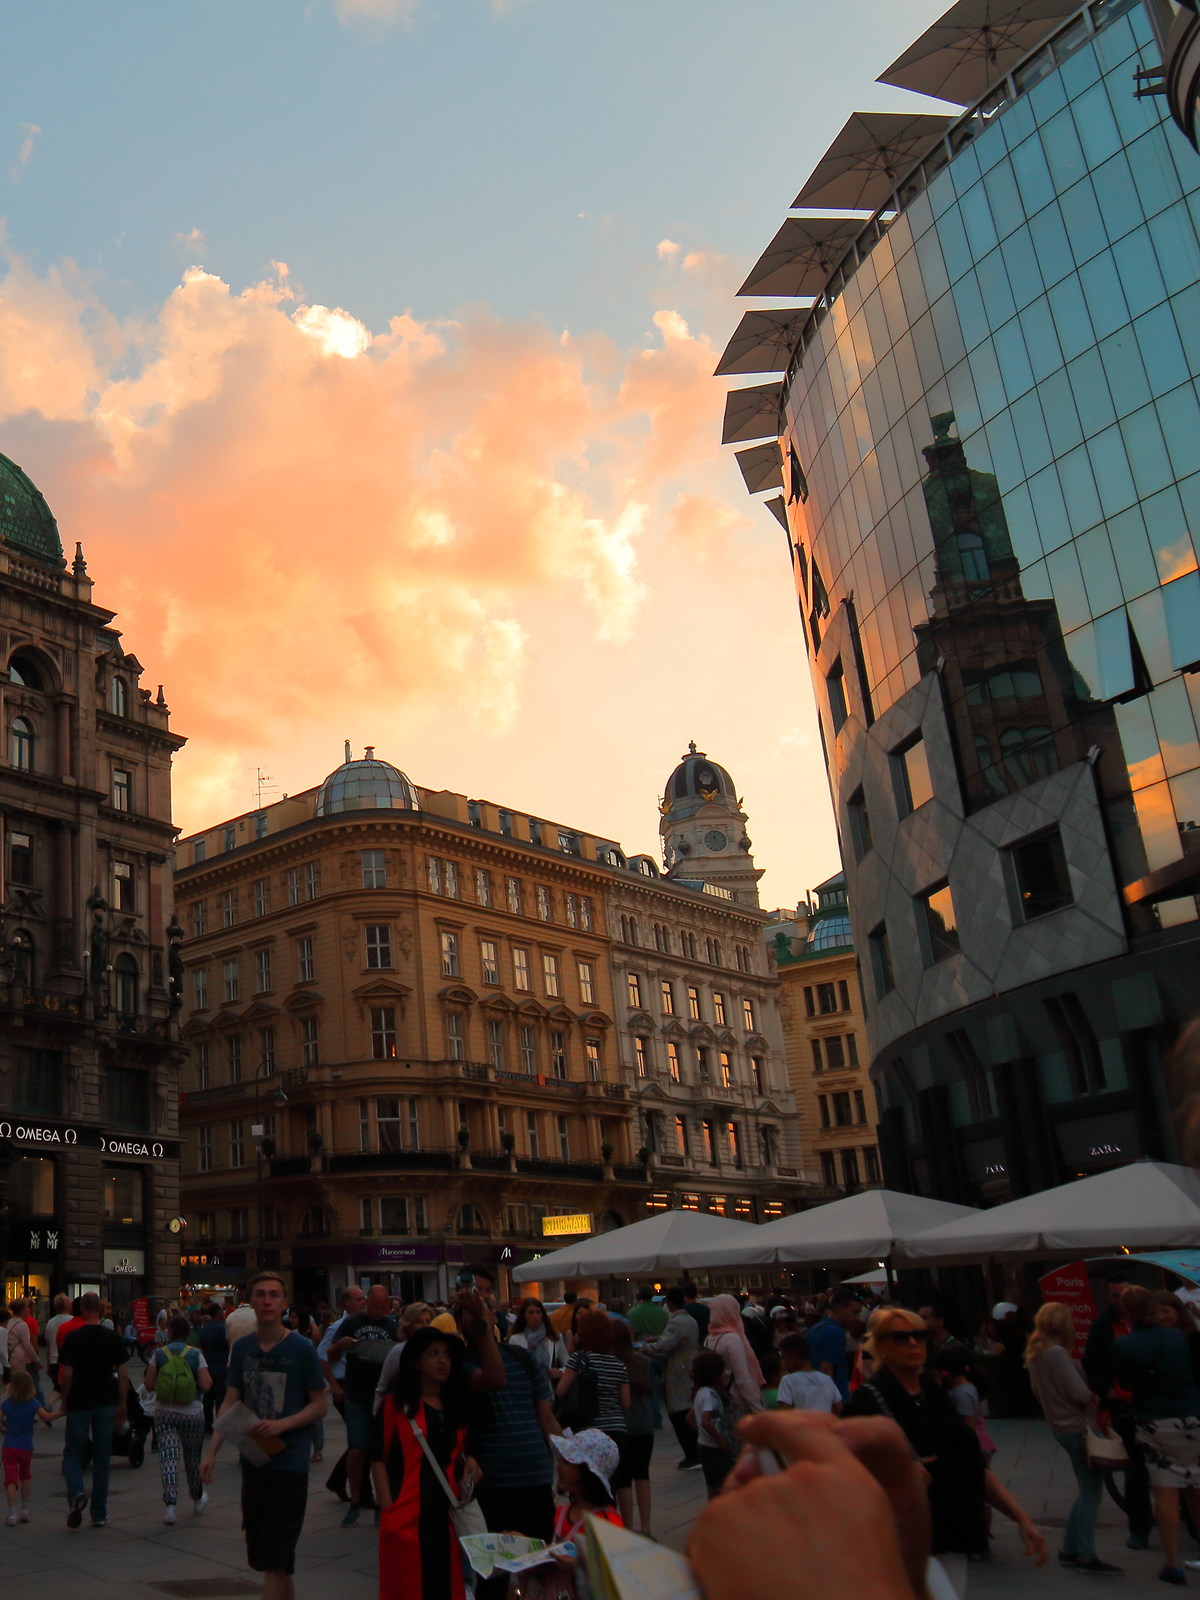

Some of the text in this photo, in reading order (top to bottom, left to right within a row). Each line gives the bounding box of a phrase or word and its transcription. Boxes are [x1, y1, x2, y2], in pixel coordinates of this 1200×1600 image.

[15, 1126, 61, 1143] OMEGA
[109, 1141, 149, 1156] OMEGA
[1089, 1144, 1121, 1156] ZARA
[114, 1265, 137, 1273] OMEGA
[1056, 1276, 1085, 1288] Paris
[1071, 1302, 1092, 1313] rich
